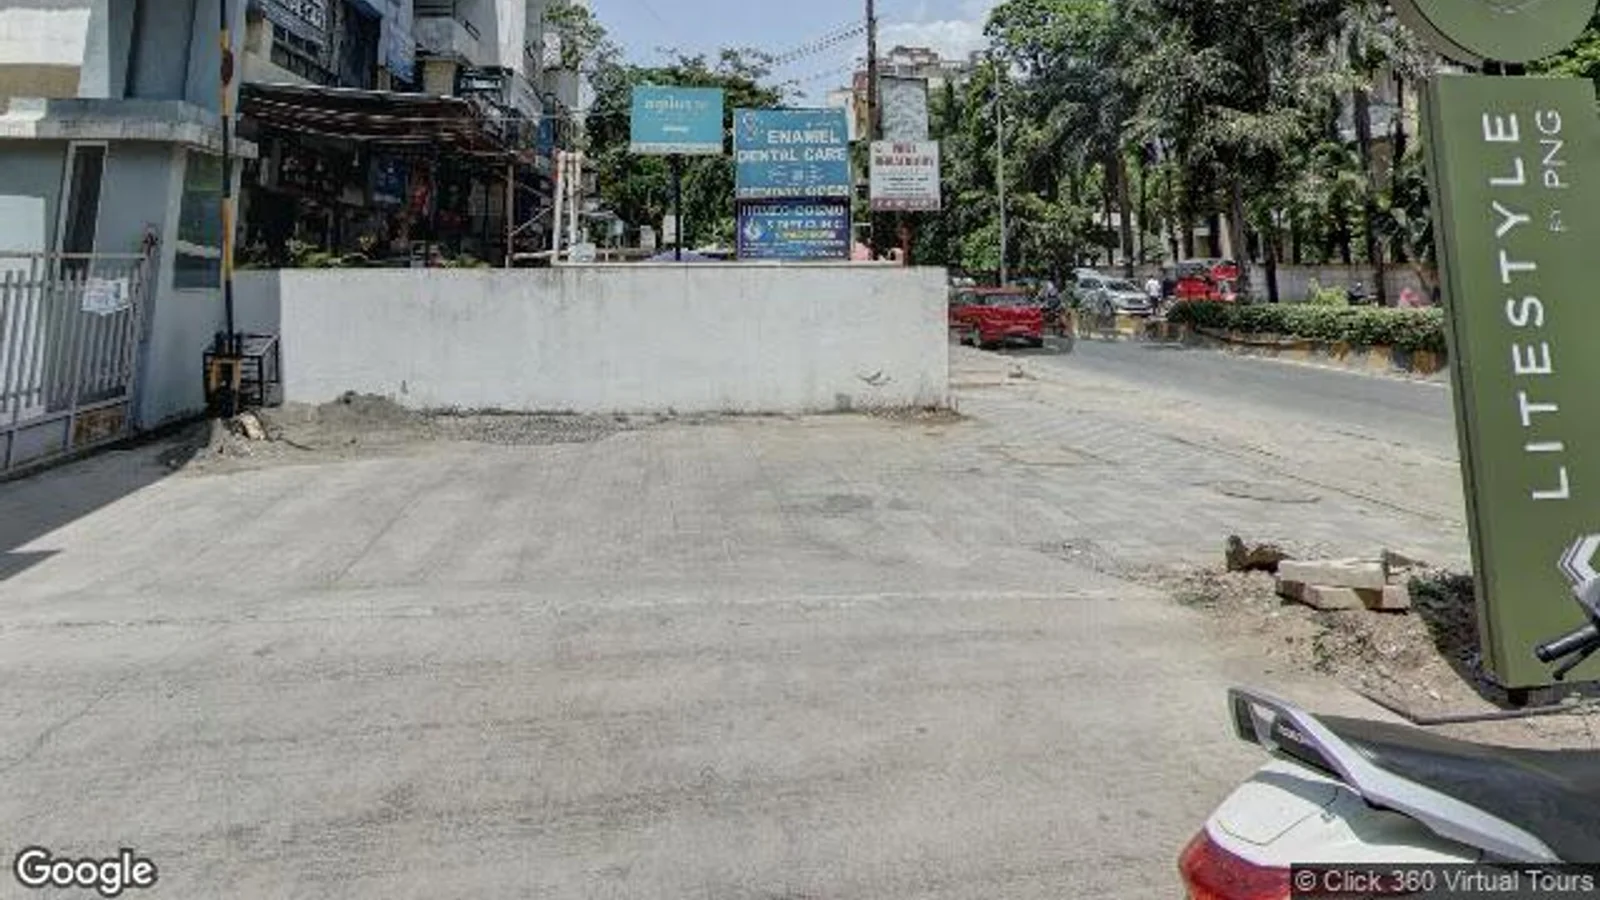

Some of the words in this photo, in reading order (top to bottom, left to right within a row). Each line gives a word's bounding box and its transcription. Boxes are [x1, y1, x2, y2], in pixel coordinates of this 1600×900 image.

[737, 148, 800, 163] DENTAL
[804, 146, 847, 161] CARE
[767, 128, 842, 144] ENAMEL
[1535, 109, 1570, 189] PNG
[1482, 110, 1571, 502] LITESTYLE
